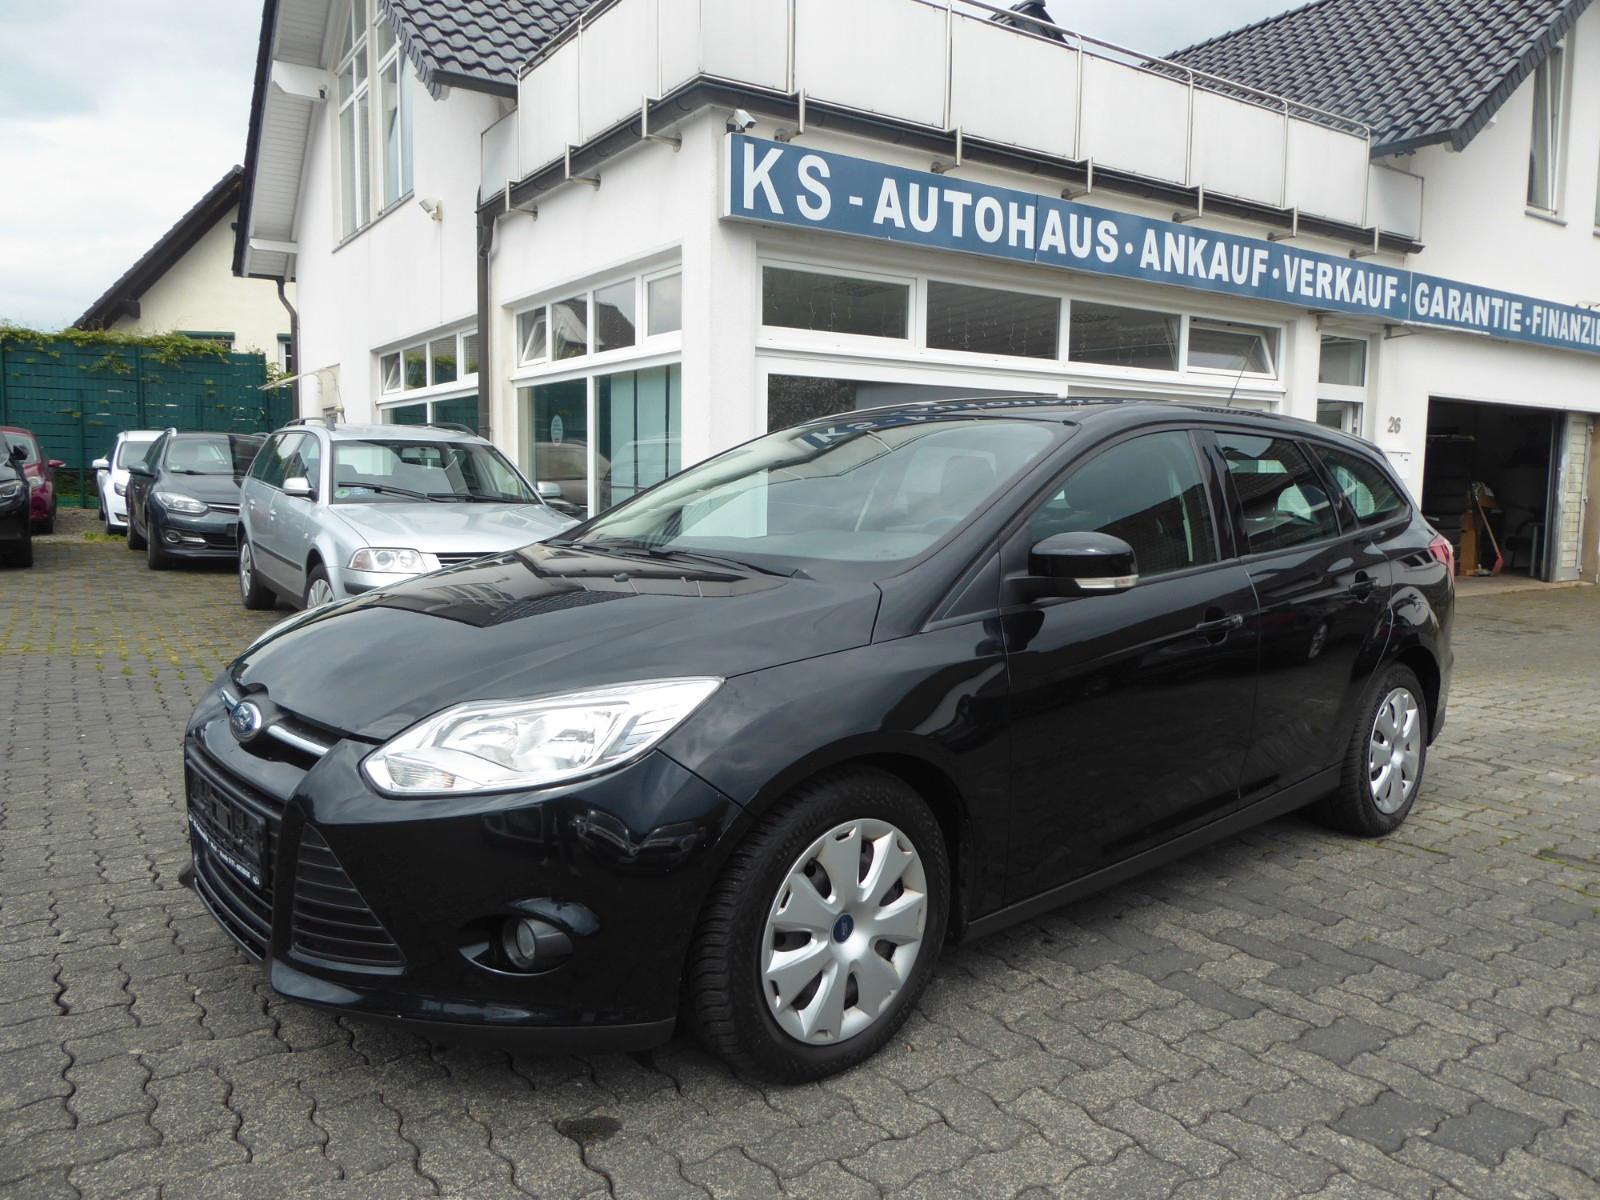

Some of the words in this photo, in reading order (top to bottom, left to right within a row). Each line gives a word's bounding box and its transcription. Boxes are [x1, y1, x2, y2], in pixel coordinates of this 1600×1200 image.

[872, 177, 1120, 264] AUTOHAUS
[1139, 228, 1269, 287] ANKAUF
[1283, 253, 1399, 310] VERKAUF
[1414, 281, 1523, 333] GARANTIE
[1387, 416, 1401, 434] 26
